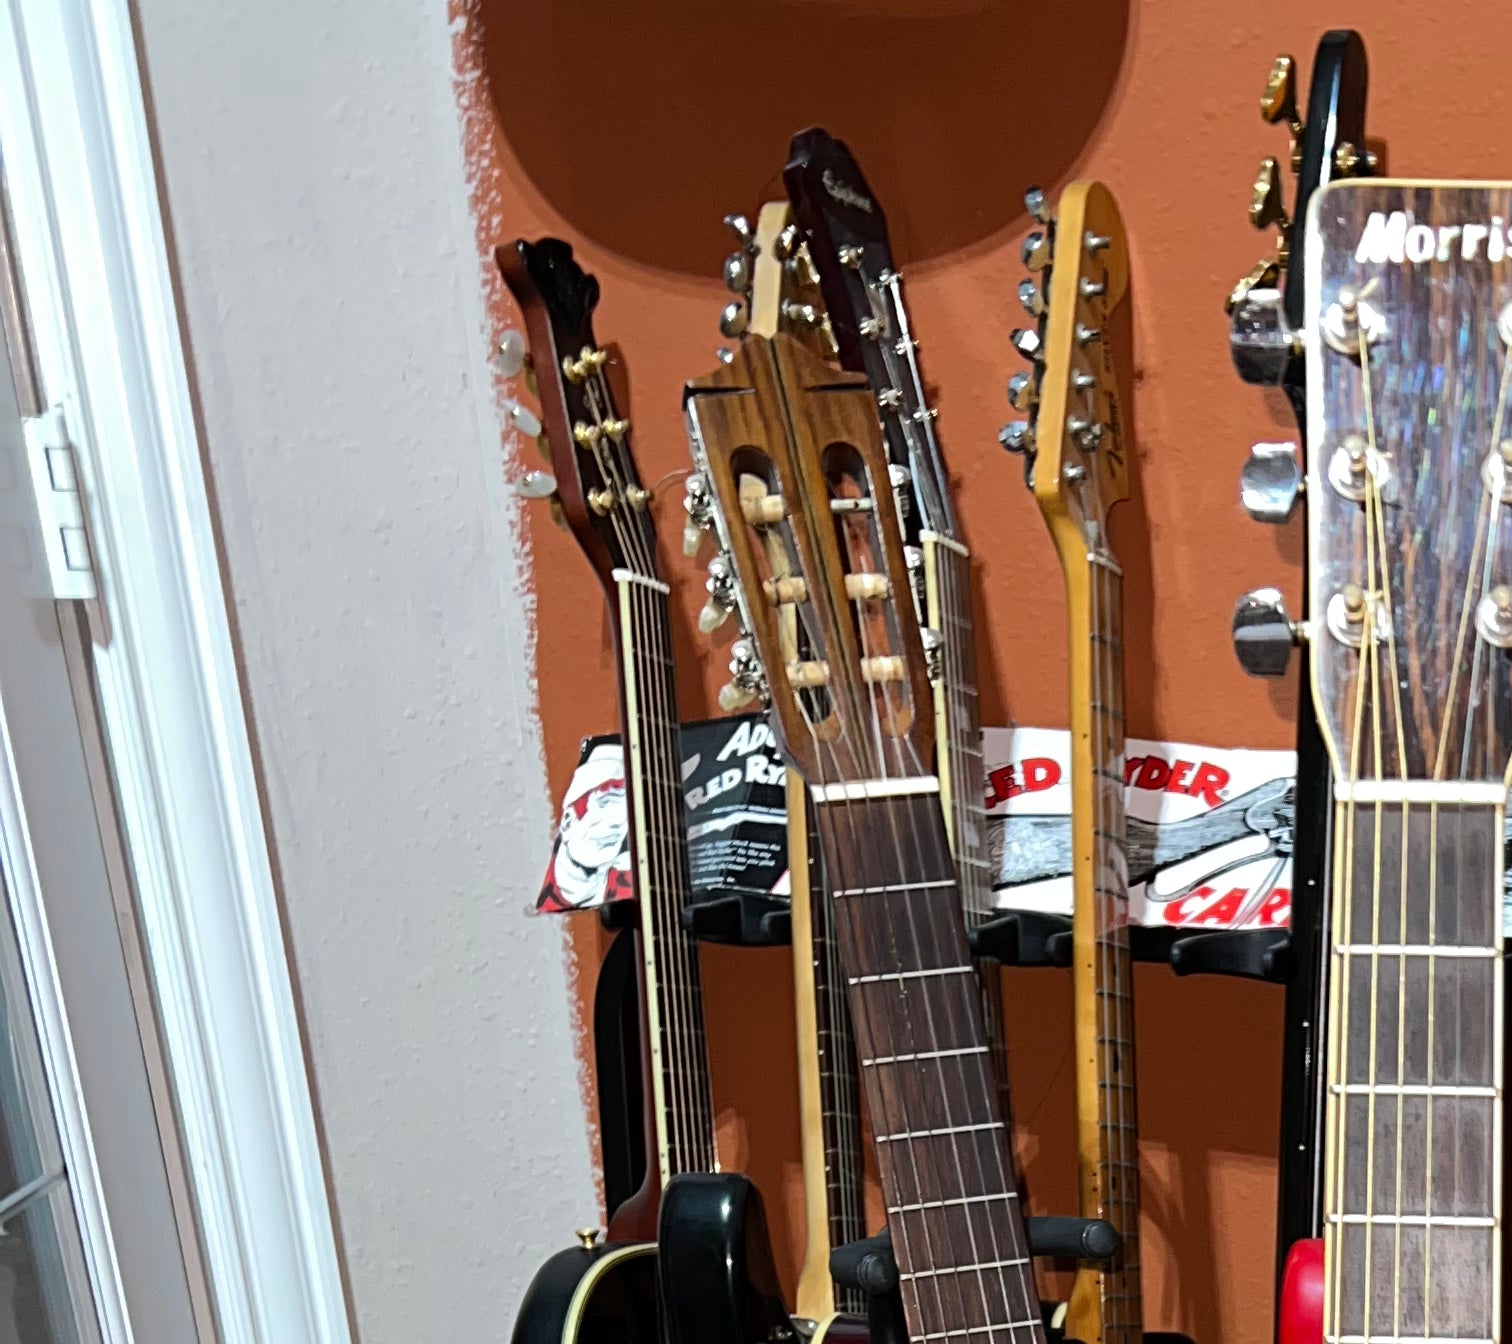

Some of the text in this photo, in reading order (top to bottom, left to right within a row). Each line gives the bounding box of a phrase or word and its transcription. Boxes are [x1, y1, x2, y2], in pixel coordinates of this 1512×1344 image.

[684, 754, 787, 810] RED RY
[984, 754, 1230, 809] ED YDER
